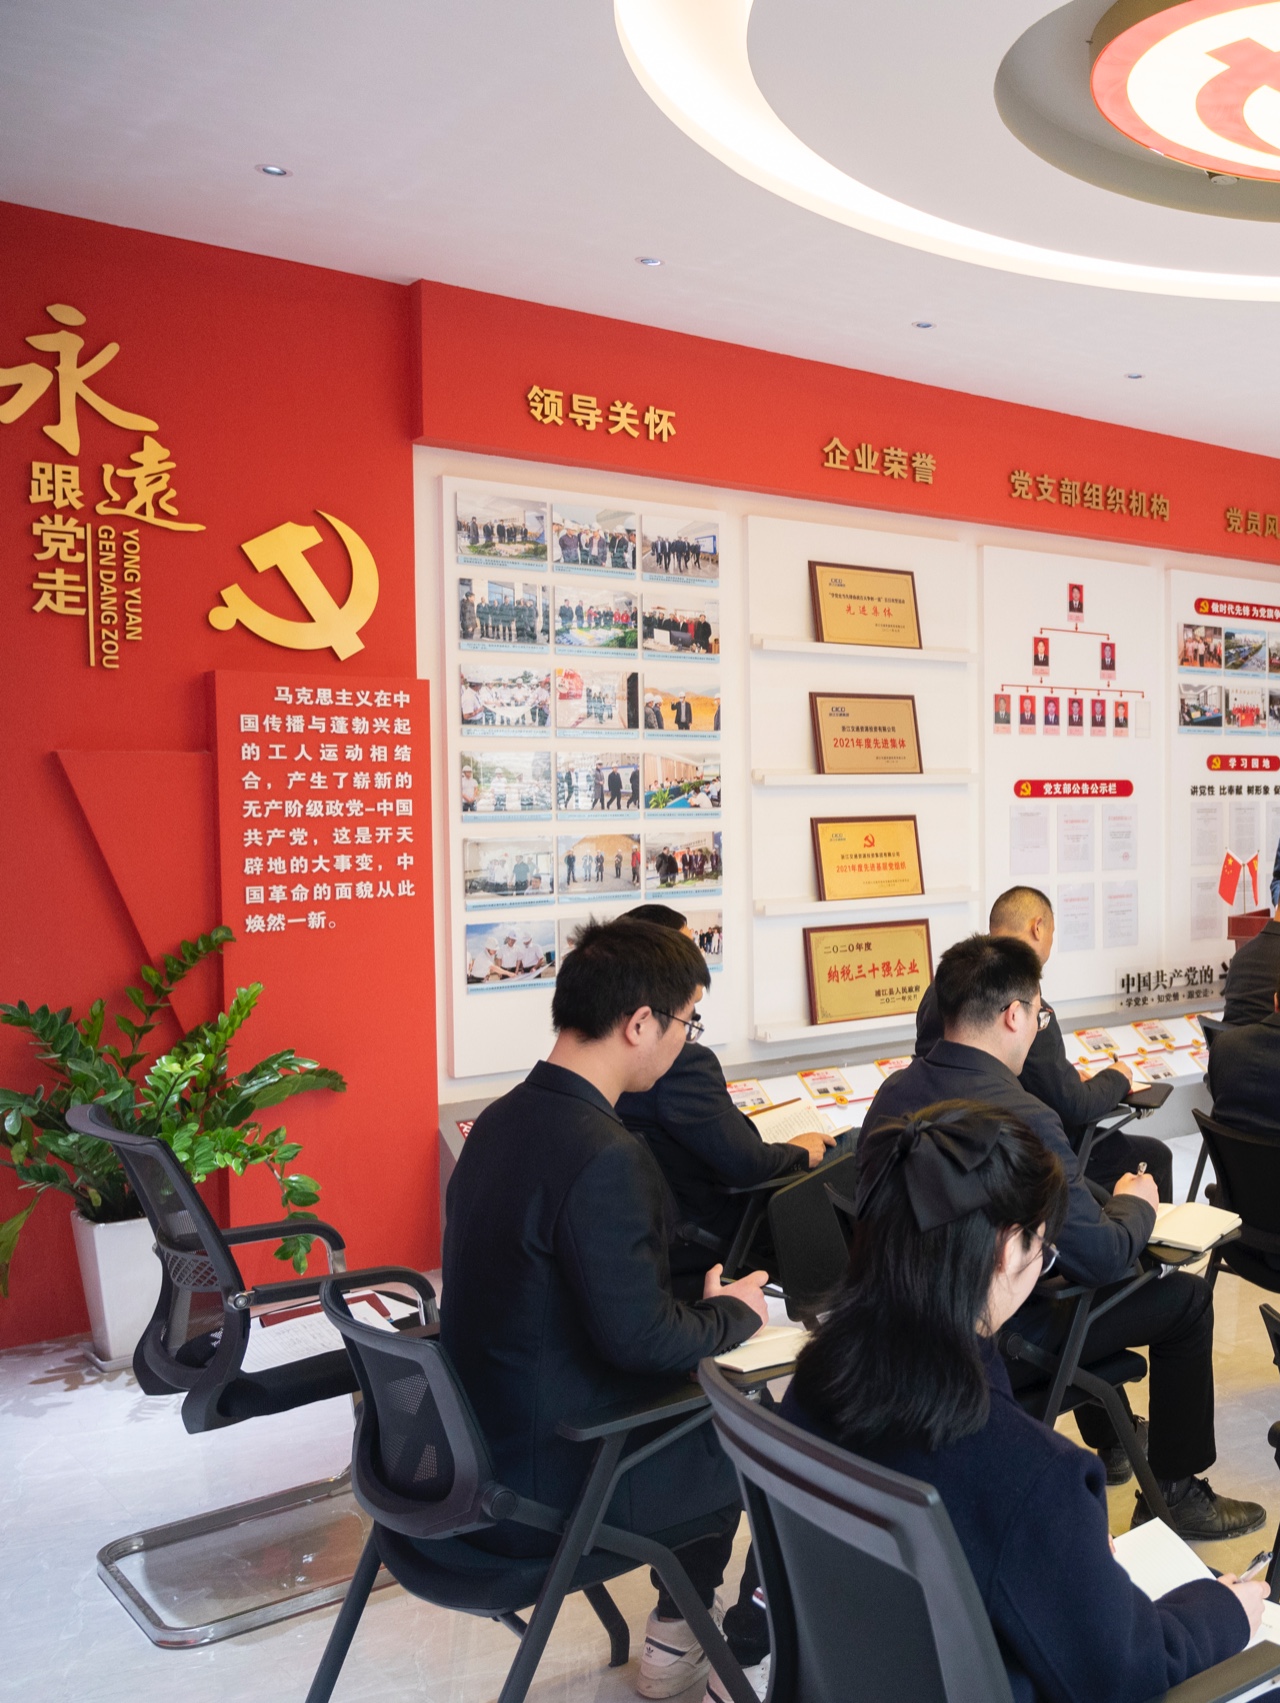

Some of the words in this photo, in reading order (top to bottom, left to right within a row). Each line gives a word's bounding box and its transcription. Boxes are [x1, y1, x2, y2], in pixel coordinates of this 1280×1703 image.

[527, 385, 676, 442] 领导关怀
[822, 436, 936, 484] 企业荣誉
[1010, 470, 1170, 522] 党支部组织机构
[29, 461, 87, 616] 跟党走
[98, 525, 116, 566] GEN
[122, 529, 141, 582] YONG
[100, 570, 118, 625] DANG
[124, 588, 142, 641] YUAN
[1212, 602, 1250, 617] 做时代先锋
[102, 629, 120, 669] ZOU
[274, 686, 410, 708] 马克思主义在中
[240, 714, 411, 735] 国传播与蓬勃兴起
[241, 743, 412, 762] 的工人运动相结
[834, 738, 906, 750] 2021年度先进集体
[1229, 757, 1270, 770] 学习园地
[241, 771, 412, 790] 合，产生了崭新的
[1043, 782, 1117, 796] 党支部公告公示栏
[1190, 784, 1215, 796] 讲党性
[1220, 784, 1243, 796] 比奉献
[1247, 784, 1270, 796] 树形象
[243, 826, 414, 847] 共产党，这是开天
[244, 853, 414, 875] 辟地的大事变，中
[246, 880, 415, 904] 国革命的面貌从此
[246, 911, 336, 933] 焕然一新。
[827, 958, 920, 984] 纳税三十强企业
[1122, 965, 1214, 994] 中国共产党的
[874, 985, 920, 998] 浦江县人民政府
[1126, 996, 1148, 1008] 学党史
